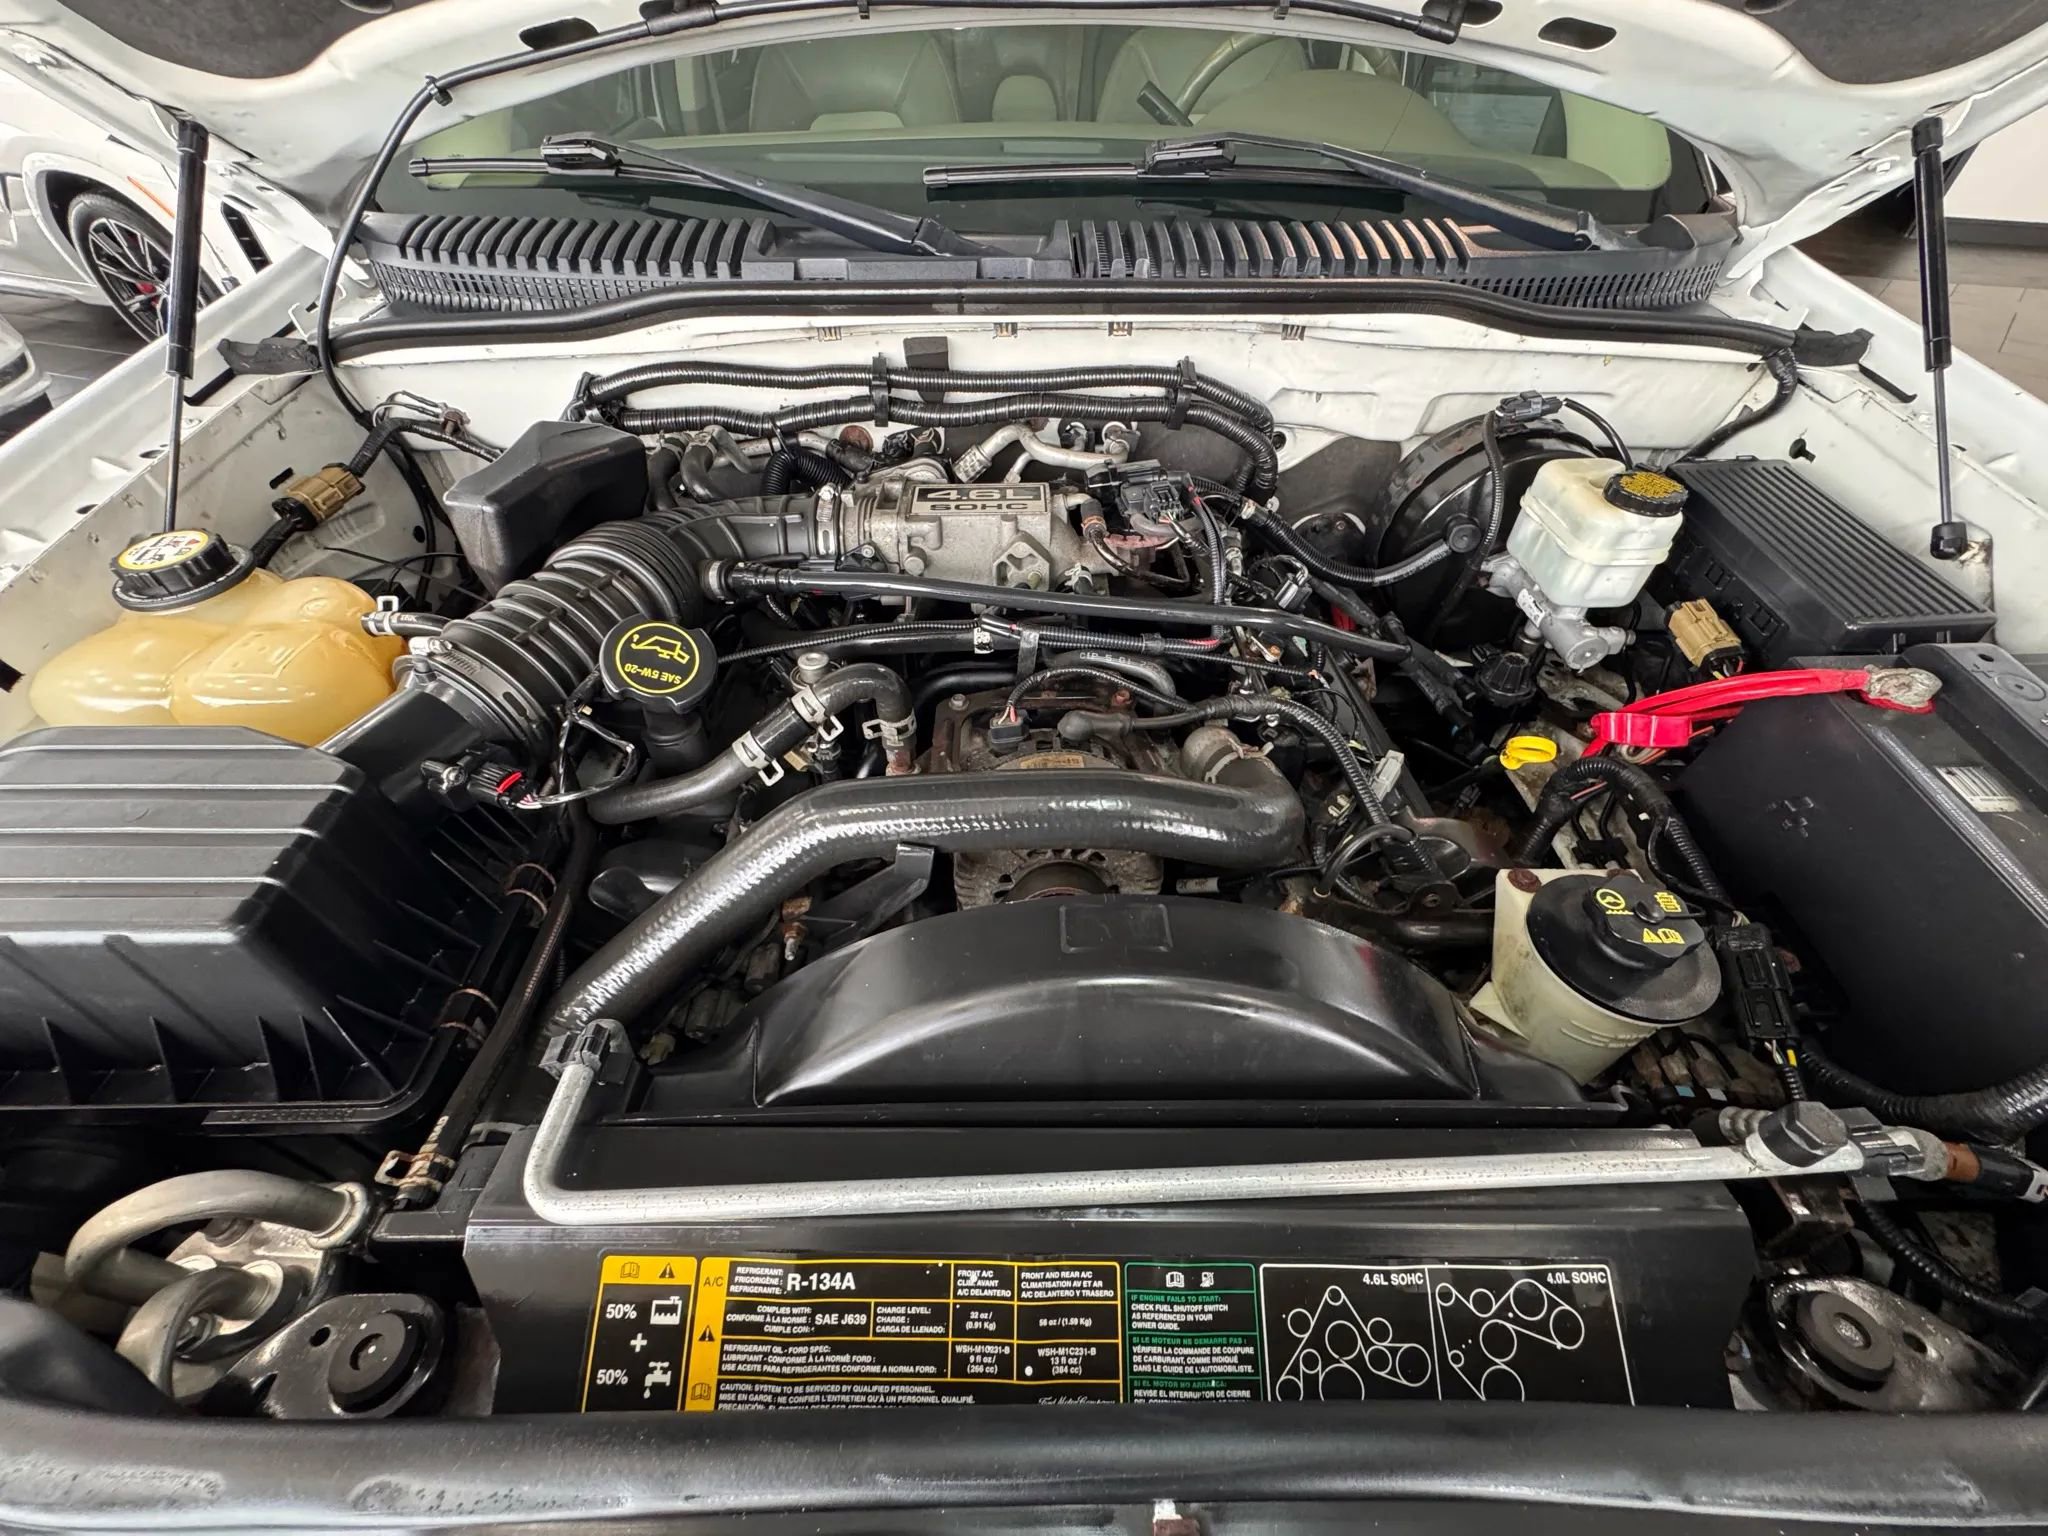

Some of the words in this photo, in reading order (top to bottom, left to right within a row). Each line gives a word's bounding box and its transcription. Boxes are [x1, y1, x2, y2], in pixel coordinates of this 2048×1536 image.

[927, 489, 1033, 500] 4.6L
[624, 663, 660, 679] 5W-20
[660, 672, 682, 684] SAE
[736, 1266, 784, 1276] REFRIGERANT:
[981, 1270, 994, 1278] A/C
[1021, 1272, 1045, 1280] FRONT
[1060, 1271, 1080, 1279] REAR
[703, 1276, 724, 1287] A/C
[786, 1272, 856, 1291] R-134A
[1362, 1274, 1388, 1285] 4.6L
[1390, 1273, 1424, 1285] SOHC
[1546, 1272, 1570, 1284] 4.0L
[1572, 1272, 1607, 1284] SOHC
[976, 1280, 999, 1288] AVANT
[1021, 1281, 1072, 1289] CLIMATISATION
[1093, 1280, 1103, 1288] AR
[729, 1285, 782, 1295] REFRIGERANTE:
[957, 1288, 969, 1296] A/C
[970, 1289, 1012, 1298] DELANTERO
[1021, 1290, 1034, 1299] A/C
[1034, 1290, 1075, 1298] DELANTERO
[1081, 1290, 1114, 1298] TRASERO
[605, 1303, 637, 1320] 50%
[757, 1305, 791, 1314] COMPLIES
[791, 1306, 812, 1314] WITH:
[876, 1306, 906, 1314] CHARGE
[1131, 1303, 1154, 1311] CHECK
[1155, 1304, 1172, 1312] FUEL
[1173, 1305, 1202, 1313] SHUTOFF
[1204, 1304, 1228, 1312] SWITCH
[726, 1314, 765, 1322] CONFORME
[772, 1315, 781, 1323] LA
[782, 1315, 807, 1324] NORME
[814, 1314, 839, 1325] SAE
[841, 1314, 867, 1325] J639
[1131, 1312, 1141, 1320] AS
[1142, 1312, 1186, 1321] REFERENCED
[1187, 1313, 1194, 1321] IN
[1195, 1313, 1213, 1321] YOUR
[764, 1325, 791, 1334] CUMPLE
[876, 1325, 900, 1333] CARGA
[1131, 1321, 1157, 1329] OWNER
[1151, 1337, 1181, 1345] MOTEUR
[723, 1344, 772, 1353] REFRIGERANT
[772, 1346, 783, 1354] OIL
[788, 1345, 809, 1354] FORD
[1037, 1347, 1097, 1357] WSH-M1C231-B
[1174, 1347, 1211, 1355] COMMANDE
[1222, 1346, 1254, 1354] COUPURE
[722, 1353, 763, 1362] LUBRIFIANT
[767, 1355, 807, 1364] CONFORME
[814, 1355, 824, 1363] LA
[852, 1355, 872, 1363] FORD
[969, 1355, 975, 1363] 9
[1050, 1357, 1059, 1365] 13
[1187, 1356, 1211, 1364] COMME
[721, 1363, 736, 1372] USE
[736, 1363, 762, 1372] ACEITE
[762, 1364, 780, 1373] PARA
[781, 1364, 840, 1374] REFRIGERANTES
[841, 1365, 881, 1373] CONFORME
[888, 1365, 914, 1373] NORMA
[1069, 1366, 1082, 1376] cc)
[1163, 1365, 1183, 1373] GUIDE
[596, 1369, 629, 1385] 50%
[720, 1383, 753, 1391] CAUTION:
[754, 1384, 782, 1393] SYSTEM
[793, 1385, 804, 1393] BE
[805, 1385, 840, 1393] SERVICED
[841, 1385, 852, 1393] BY
[852, 1385, 890, 1393] QUALIFIED
[719, 1393, 737, 1401] MISE
[737, 1393, 748, 1401] EN
[748, 1393, 773, 1402] GARDE
[777, 1395, 787, 1403] NE
[788, 1395, 820, 1404] CONFIER
[885, 1395, 897, 1403] UN
[897, 1395, 940, 1404] PERSONNEL
[1134, 1389, 1157, 1398] REVISE
[1159, 1390, 1167, 1398] EL
[1216, 1390, 1225, 1398] DE
[1226, 1390, 1250, 1398] CIERRE
